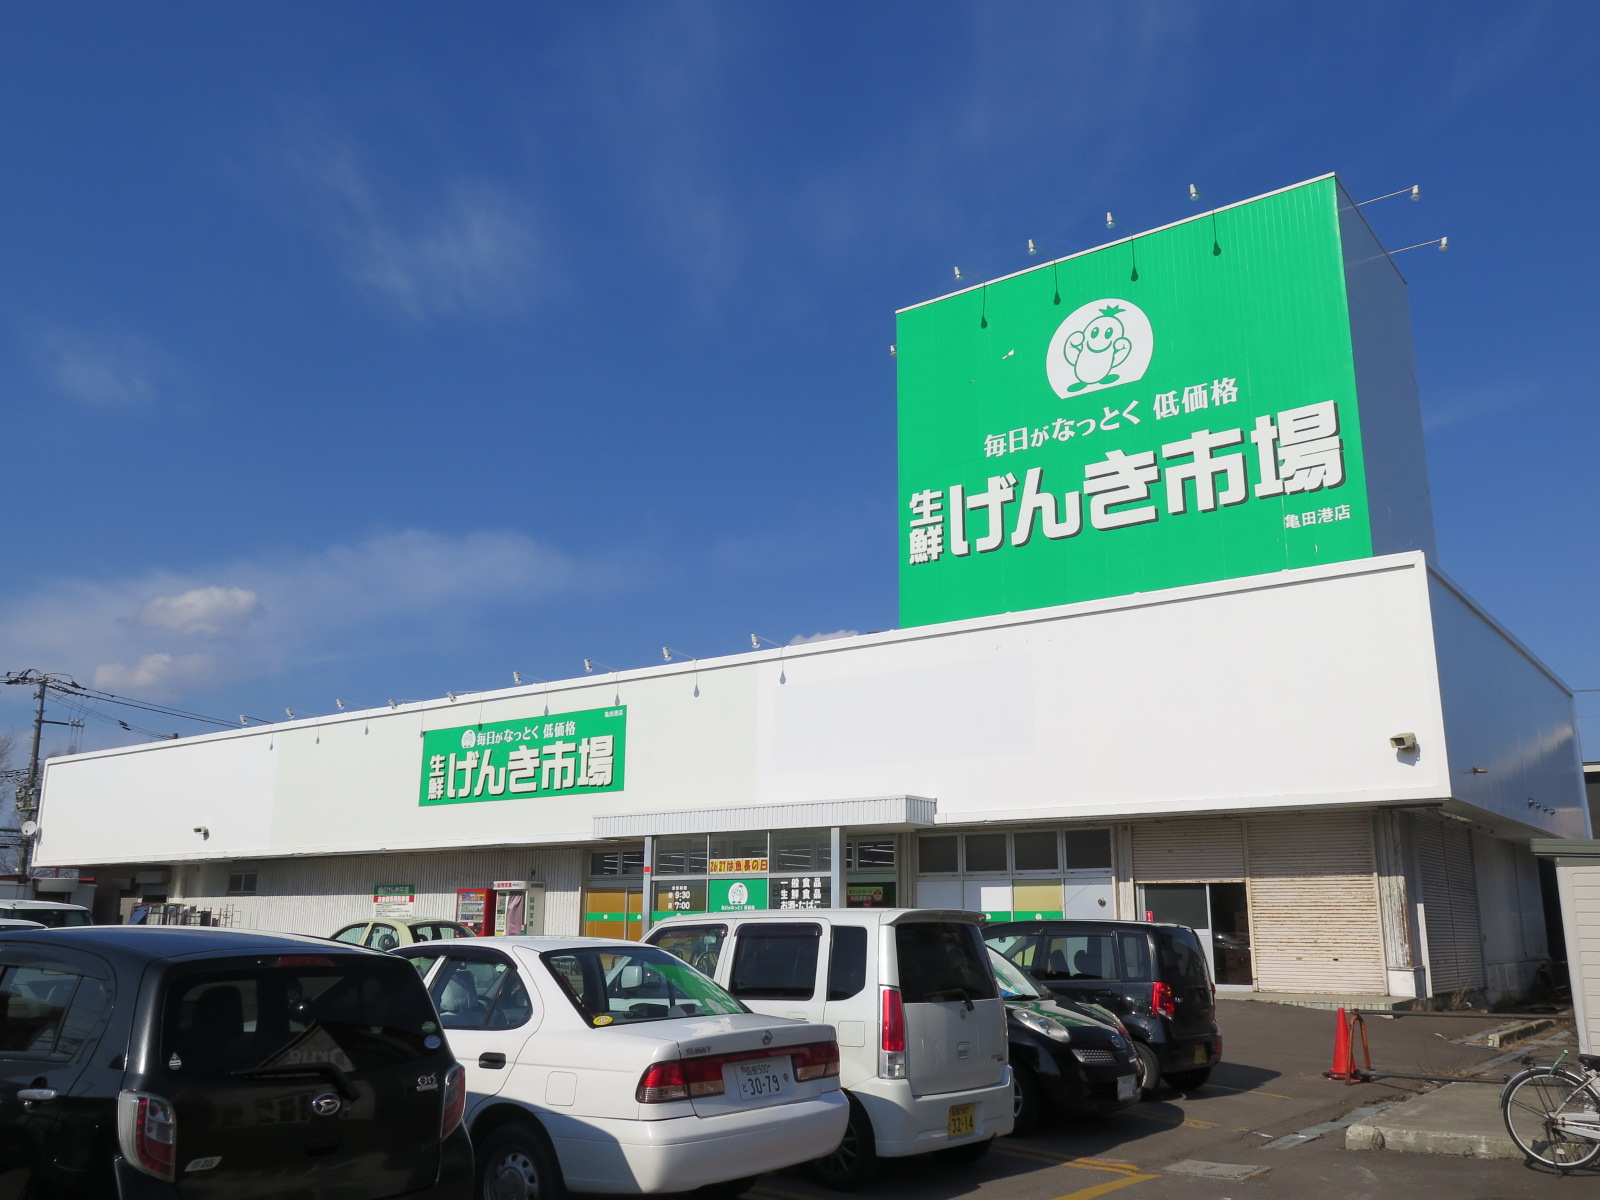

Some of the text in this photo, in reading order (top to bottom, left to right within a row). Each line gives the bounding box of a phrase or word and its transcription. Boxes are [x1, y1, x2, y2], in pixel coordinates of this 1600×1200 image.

[983, 376, 1239, 458] 毎日がなっとく 低価格
[949, 399, 1344, 557] げんき市場
[909, 489, 944, 566] 生鮮
[1284, 504, 1351, 530] 亀田港店
[476, 720, 576, 746] 毎日がなっとく 低価格
[428, 754, 446, 801] 生鮮
[446, 734, 614, 799] げんき市場
[675, 891, 691, 900] 9:30
[780, 877, 822, 888] 一般食品
[780, 888, 822, 900] 生鮮食品
[674, 901, 691, 910] 7:00
[685, 1046, 713, 1056] SUNNY
